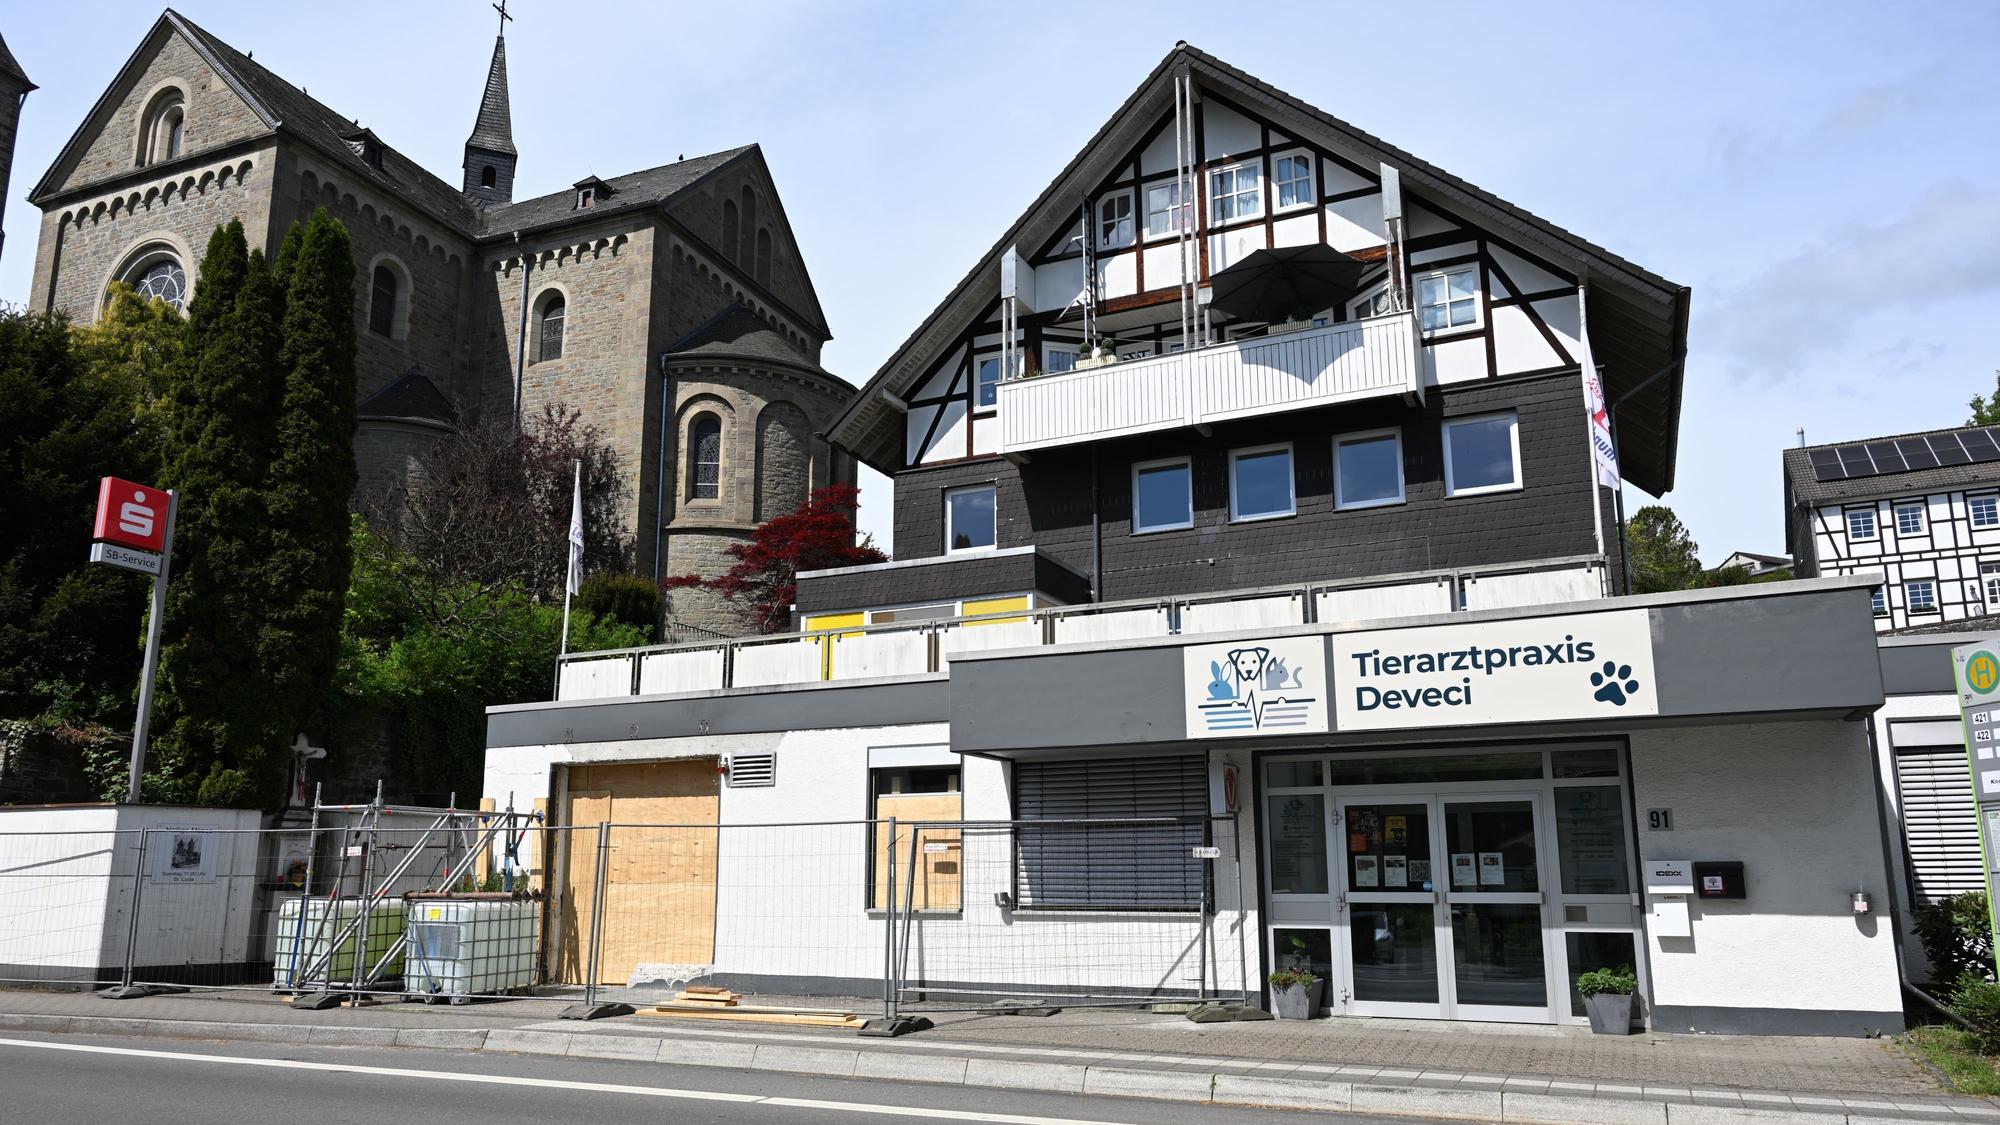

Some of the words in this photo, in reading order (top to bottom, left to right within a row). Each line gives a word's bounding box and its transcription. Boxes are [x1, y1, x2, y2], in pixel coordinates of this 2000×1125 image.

[106, 549, 156, 569] SB-Service
[1351, 634, 1596, 676] Tierarztpraxis
[1355, 676, 1473, 712] Deveci
[1974, 712, 1987, 723] 421
[1976, 730, 1990, 740] 422
[1650, 810, 1669, 829] 91
